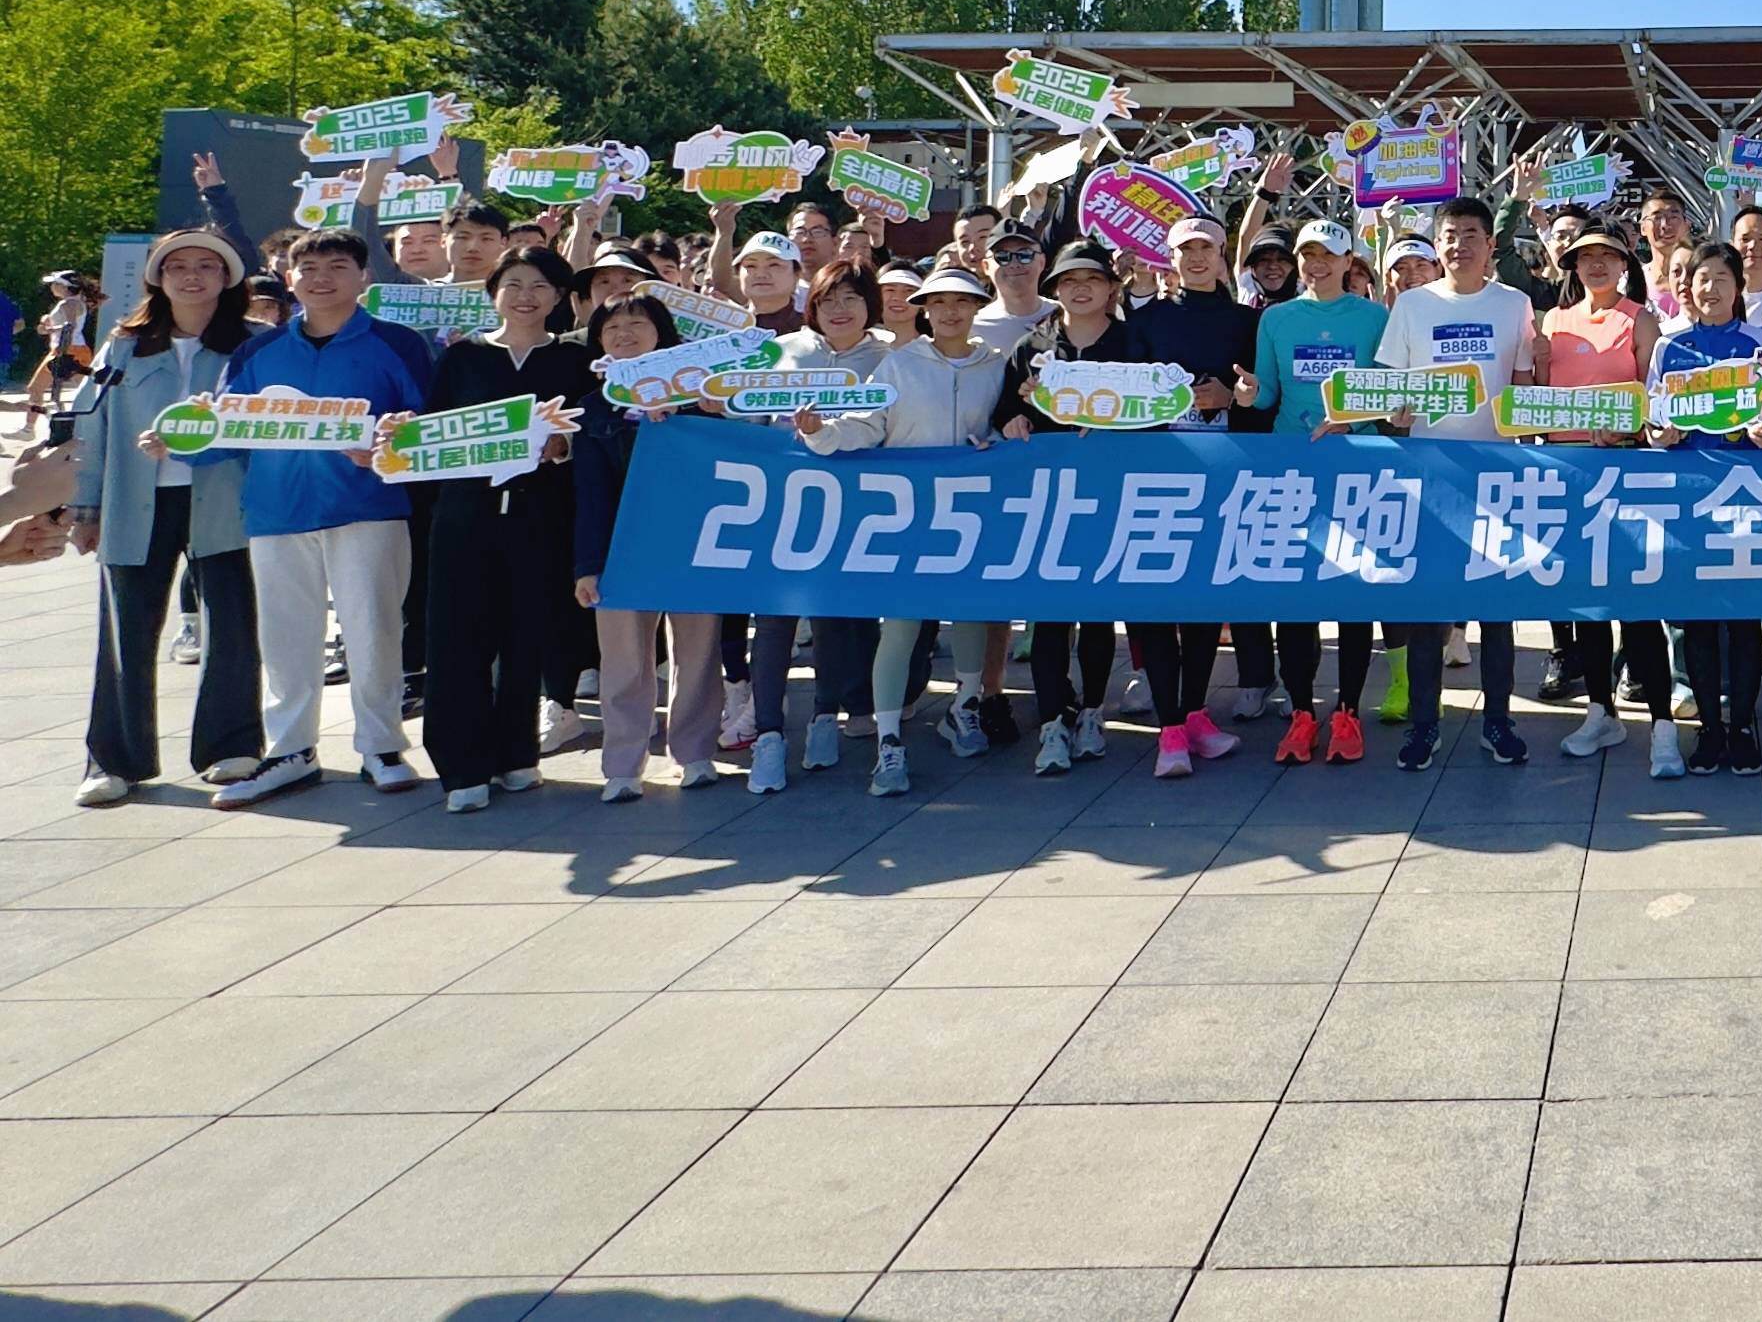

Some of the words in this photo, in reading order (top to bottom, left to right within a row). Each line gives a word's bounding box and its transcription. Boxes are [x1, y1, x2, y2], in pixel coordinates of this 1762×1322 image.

[1030, 65, 1092, 96] 2025
[1015, 82, 1096, 122] 北居健跑
[339, 104, 410, 130] 2025
[330, 127, 428, 154] 北居健跑
[840, 154, 922, 202] 全场最佳
[1551, 159, 1597, 182] 2025
[1547, 179, 1606, 200] 北居健跑
[1441, 340, 1488, 353] B8888
[721, 372, 848, 387] 践行全民健康
[1344, 371, 1468, 392] 领跑家居行业
[218, 398, 367, 416] 只要我跑的快
[744, 389, 888, 407] 领跑行业先锋
[1343, 392, 1468, 413] 跑出美好生活
[1514, 387, 1632, 410] 领跑家居行业
[162, 419, 214, 435] emo
[420, 407, 509, 441] 2025
[1512, 407, 1632, 430] 跑出美好生活
[222, 421, 362, 442] 就追不上我
[410, 439, 529, 472] 北居健跑
[691, 464, 1420, 587] 2025北居健跑
